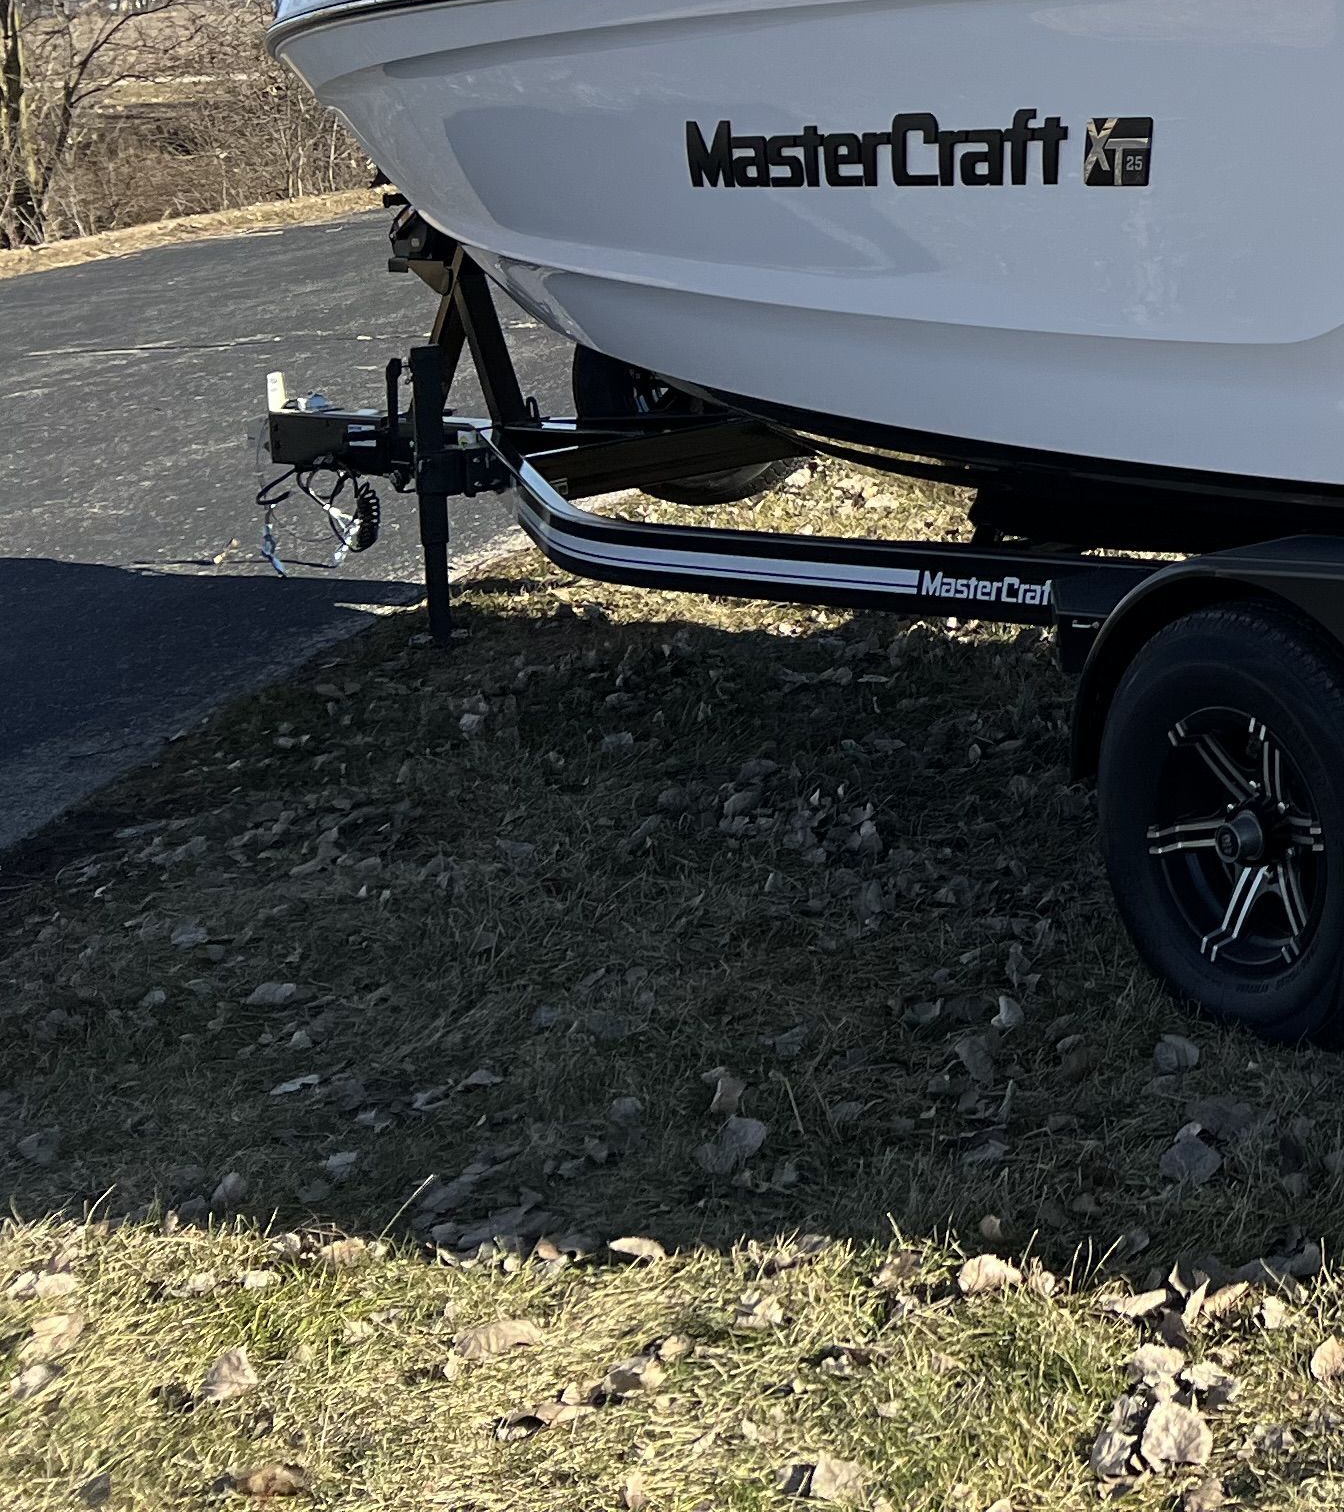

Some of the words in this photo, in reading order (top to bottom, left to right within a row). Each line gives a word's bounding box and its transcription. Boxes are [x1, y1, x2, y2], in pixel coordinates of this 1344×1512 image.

[686, 108, 1068, 188] MasterCraft
[1084, 117, 1149, 186] XT
[1126, 155, 1143, 171] 25
[921, 570, 1053, 606] MasterCraf
